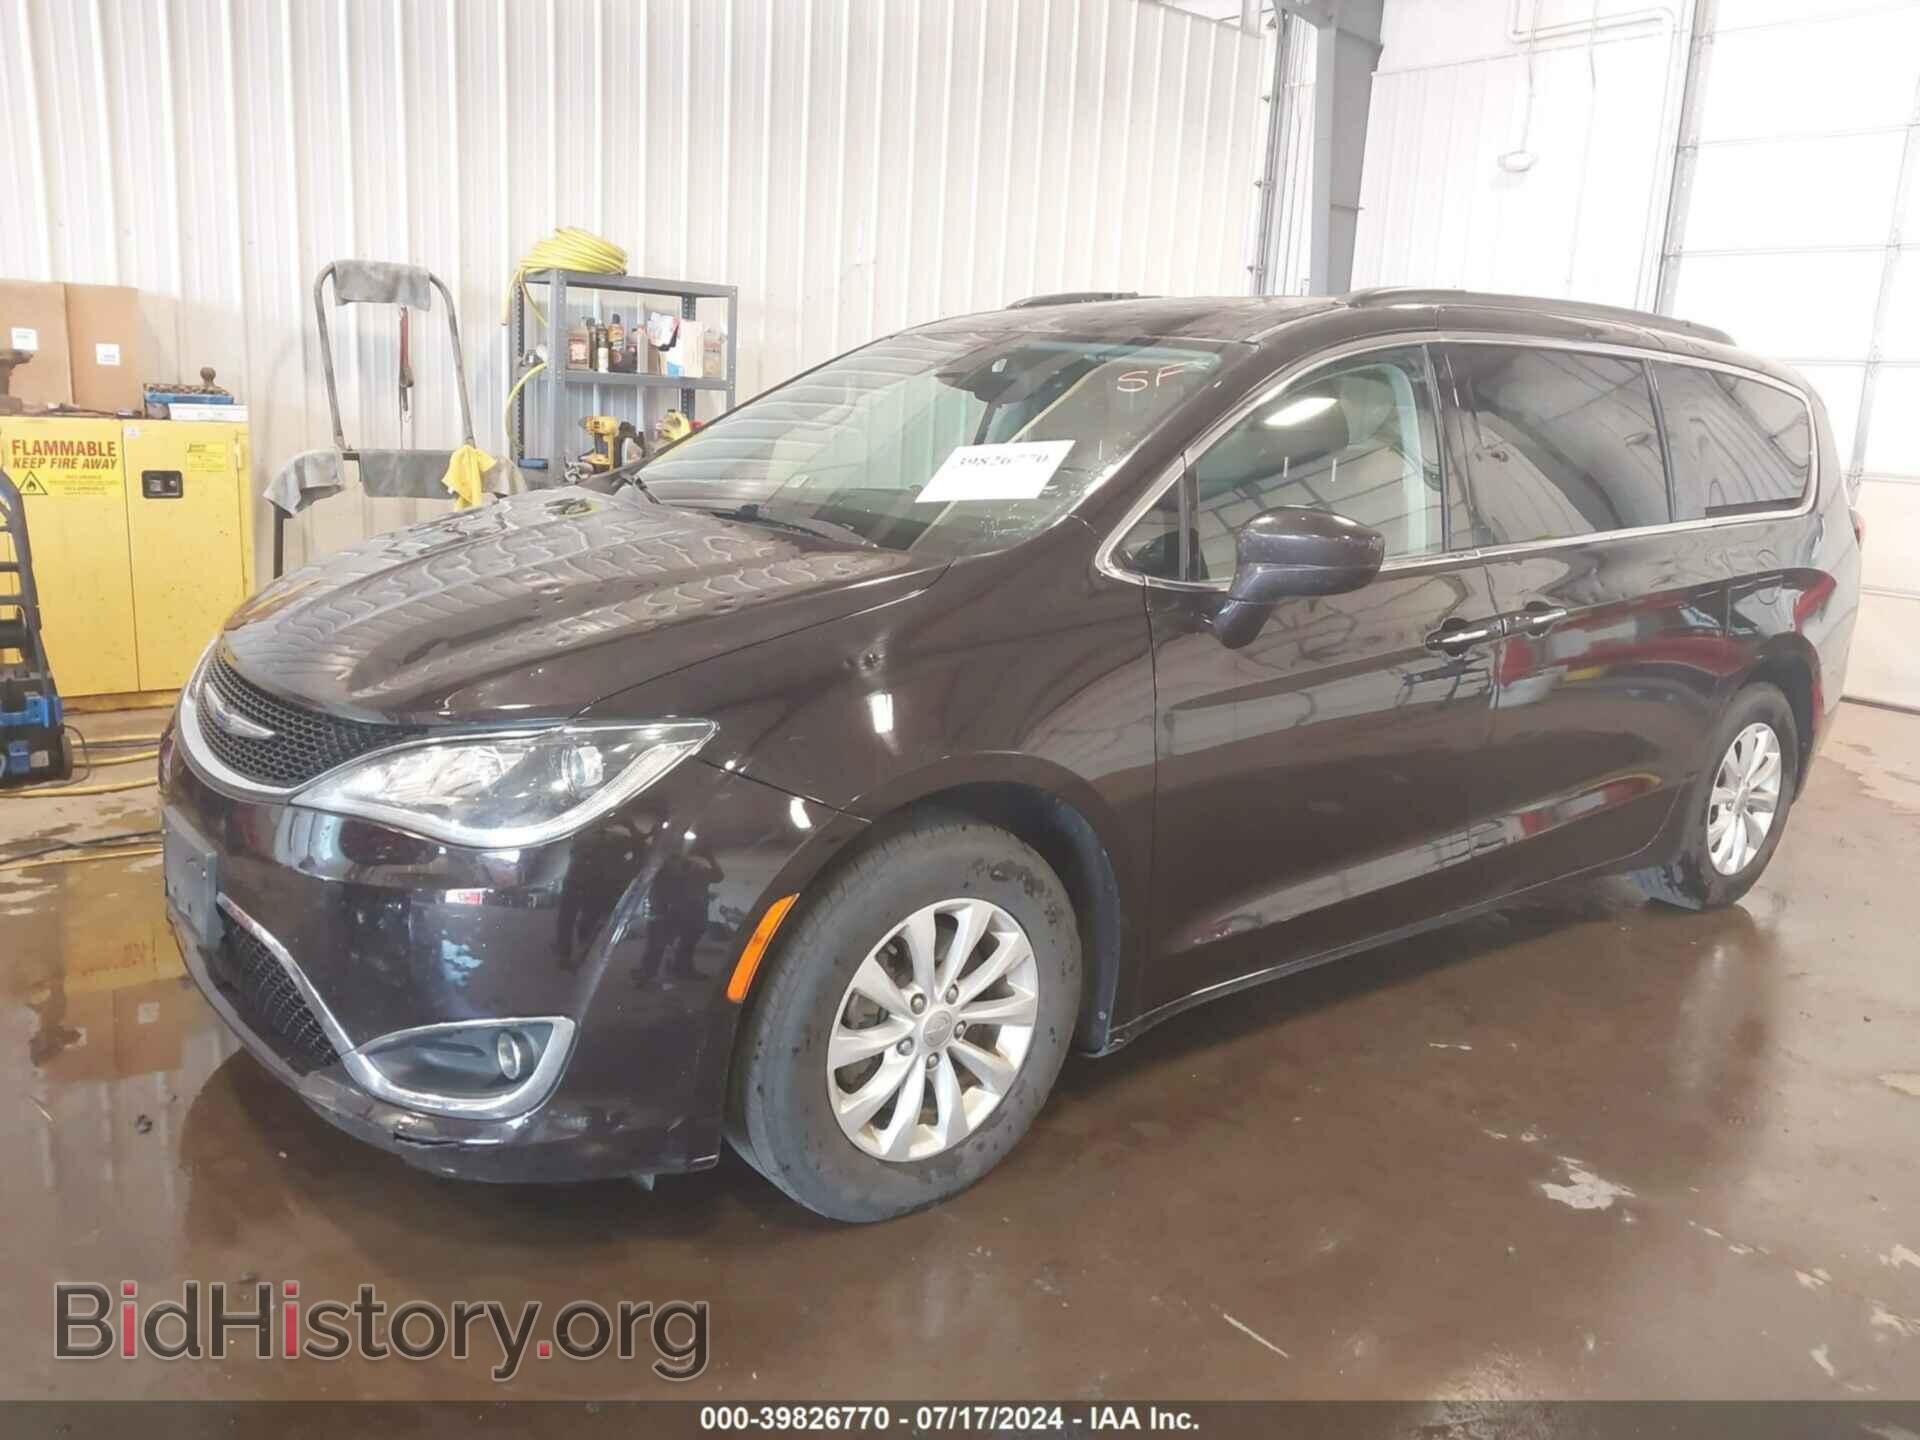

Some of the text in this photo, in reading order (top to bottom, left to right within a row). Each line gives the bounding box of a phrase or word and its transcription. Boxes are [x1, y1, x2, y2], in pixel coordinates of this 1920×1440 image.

[1117, 361, 1192, 392] SF
[12, 440, 117, 457] FLAMMABLE
[13, 457, 118, 470] KEEP FIRE AWAY
